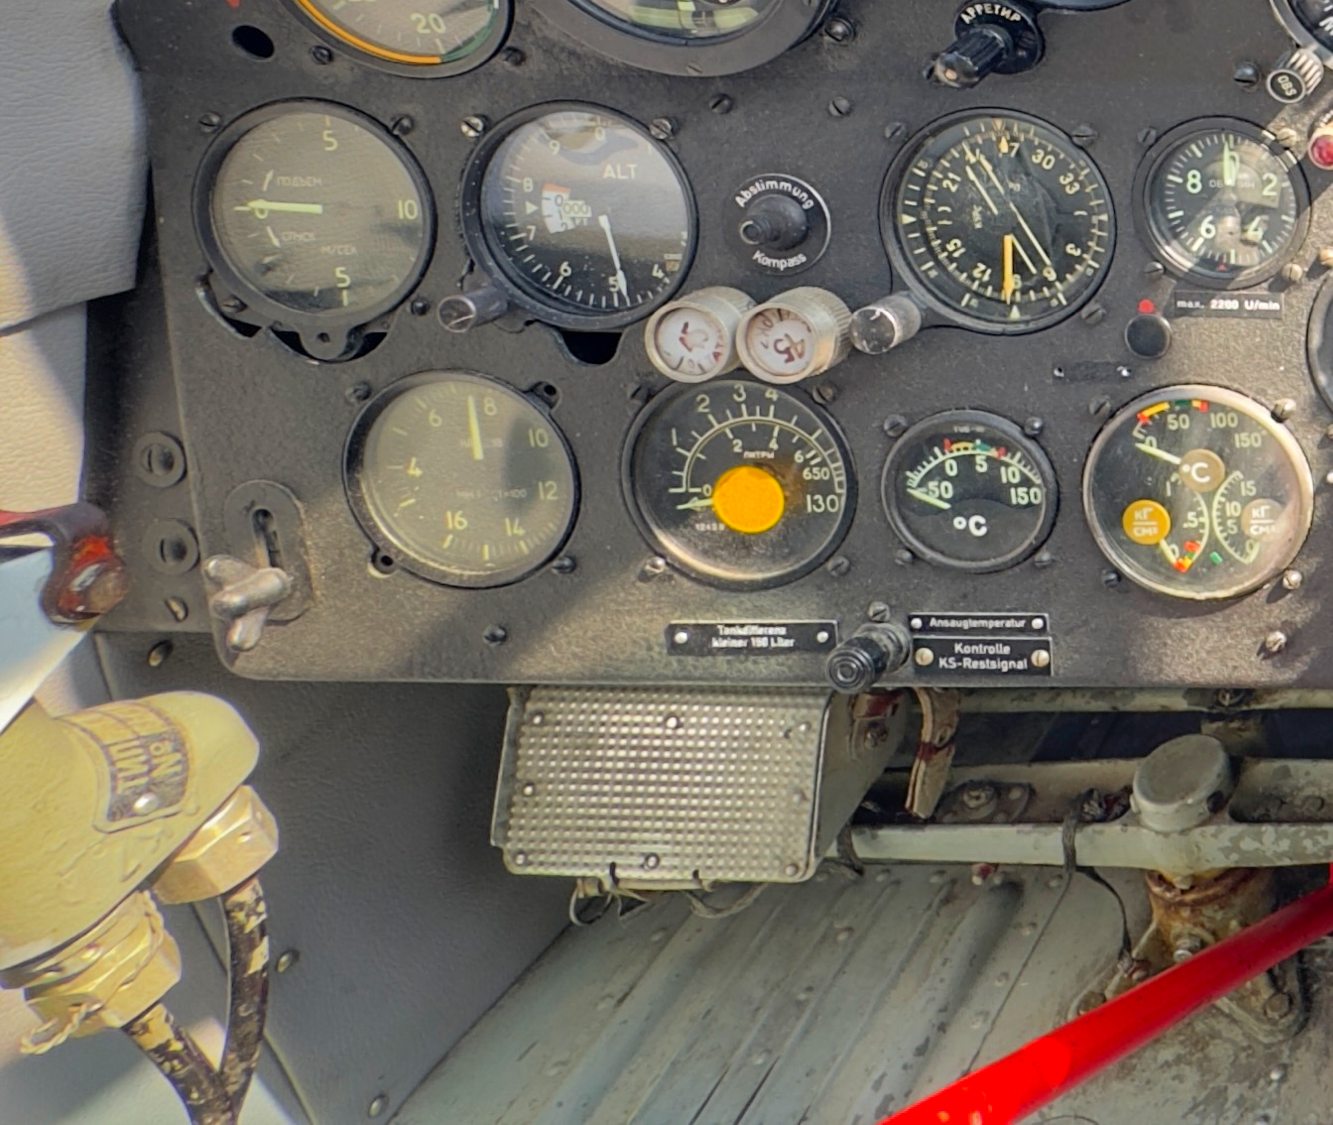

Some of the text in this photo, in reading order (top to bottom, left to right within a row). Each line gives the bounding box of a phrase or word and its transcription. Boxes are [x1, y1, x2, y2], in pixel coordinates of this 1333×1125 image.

[961, 4, 1021, 24] АРРЕТИР
[411, 12, 445, 34] 20
[1277, 76, 1296, 96] OBS
[604, 164, 637, 180] ALT
[734, 180, 814, 209] Abstimmung
[752, 250, 807, 271] Kompass
[1210, 298, 1239, 310] 2200
[1245, 299, 1280, 312] U/min
[1209, 412, 1238, 428] 100
[1234, 431, 1261, 448] 150
[802, 467, 829, 480] 650
[805, 494, 839, 512] 130
[1009, 488, 1042, 505] 150
[929, 617, 1026, 630] Ansaugtemperatur
[954, 643, 1011, 655] Kontrolle
[939, 656, 1028, 670] KS-Restsignal
